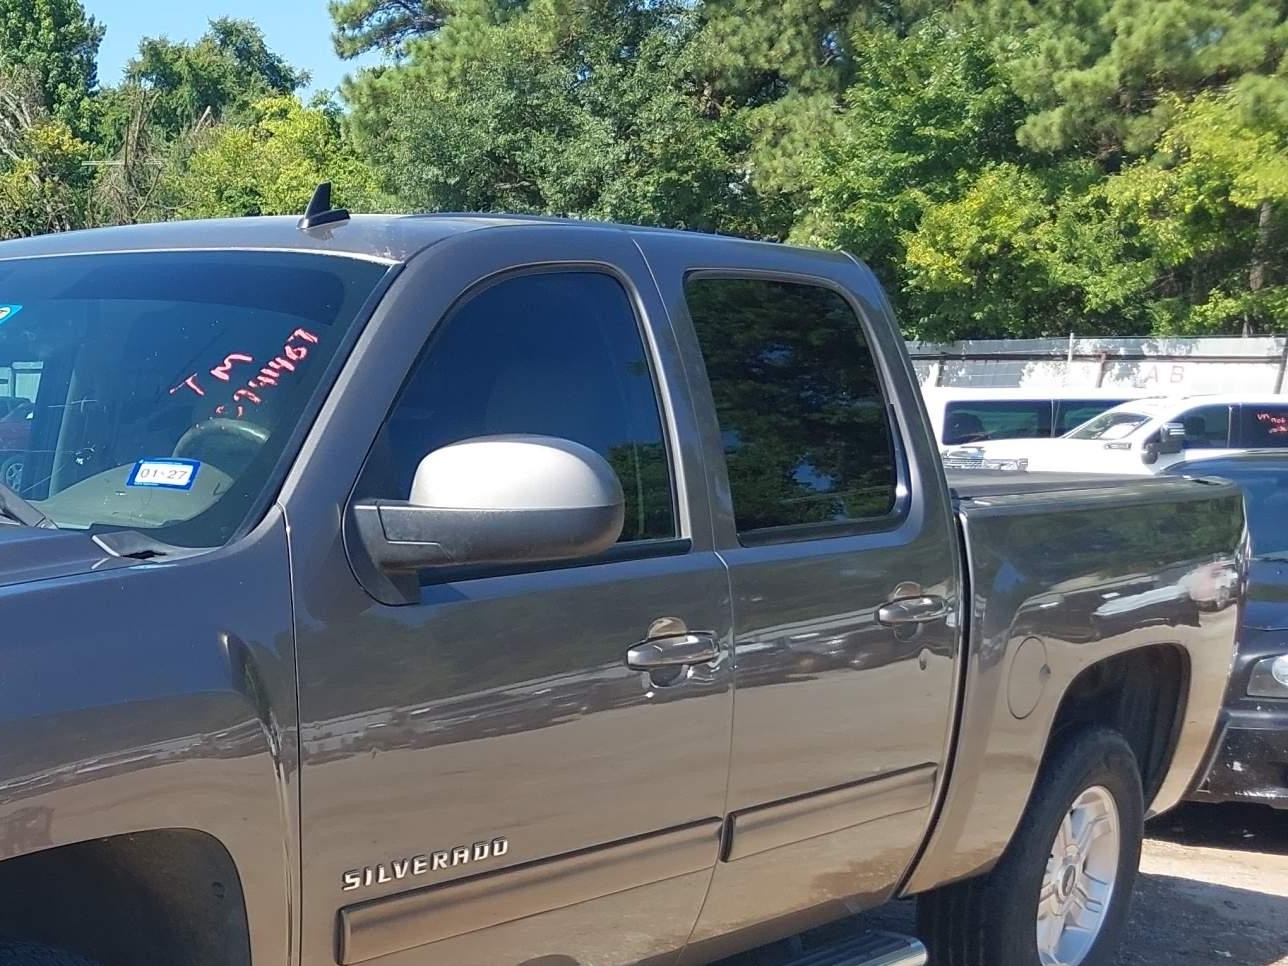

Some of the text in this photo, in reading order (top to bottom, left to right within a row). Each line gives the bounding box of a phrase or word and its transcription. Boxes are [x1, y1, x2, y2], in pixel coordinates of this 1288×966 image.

[168, 353, 254, 397] T M
[341, 836, 510, 892] SILVERADO
